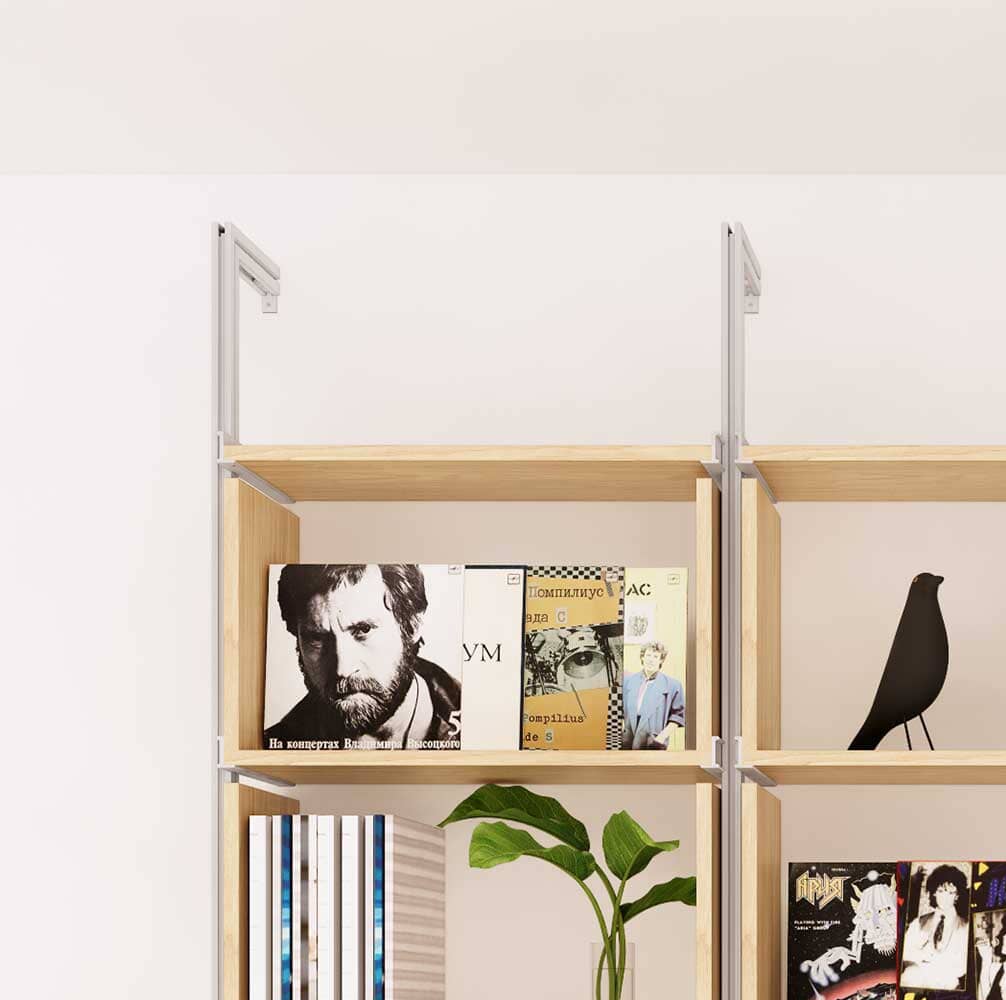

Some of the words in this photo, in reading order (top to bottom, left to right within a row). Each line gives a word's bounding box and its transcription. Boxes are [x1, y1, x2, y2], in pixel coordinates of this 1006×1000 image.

[528, 586, 604, 600] Помпилиус
[462, 643, 502, 662] УМ
[448, 711, 460, 736] 5
[269, 738, 283, 749] На
[287, 740, 340, 750] концертах
[344, 738, 403, 750] Владимира
[407, 738, 460, 750] Высоцкого
[525, 732, 539, 742] de
[545, 732, 553, 742] S
